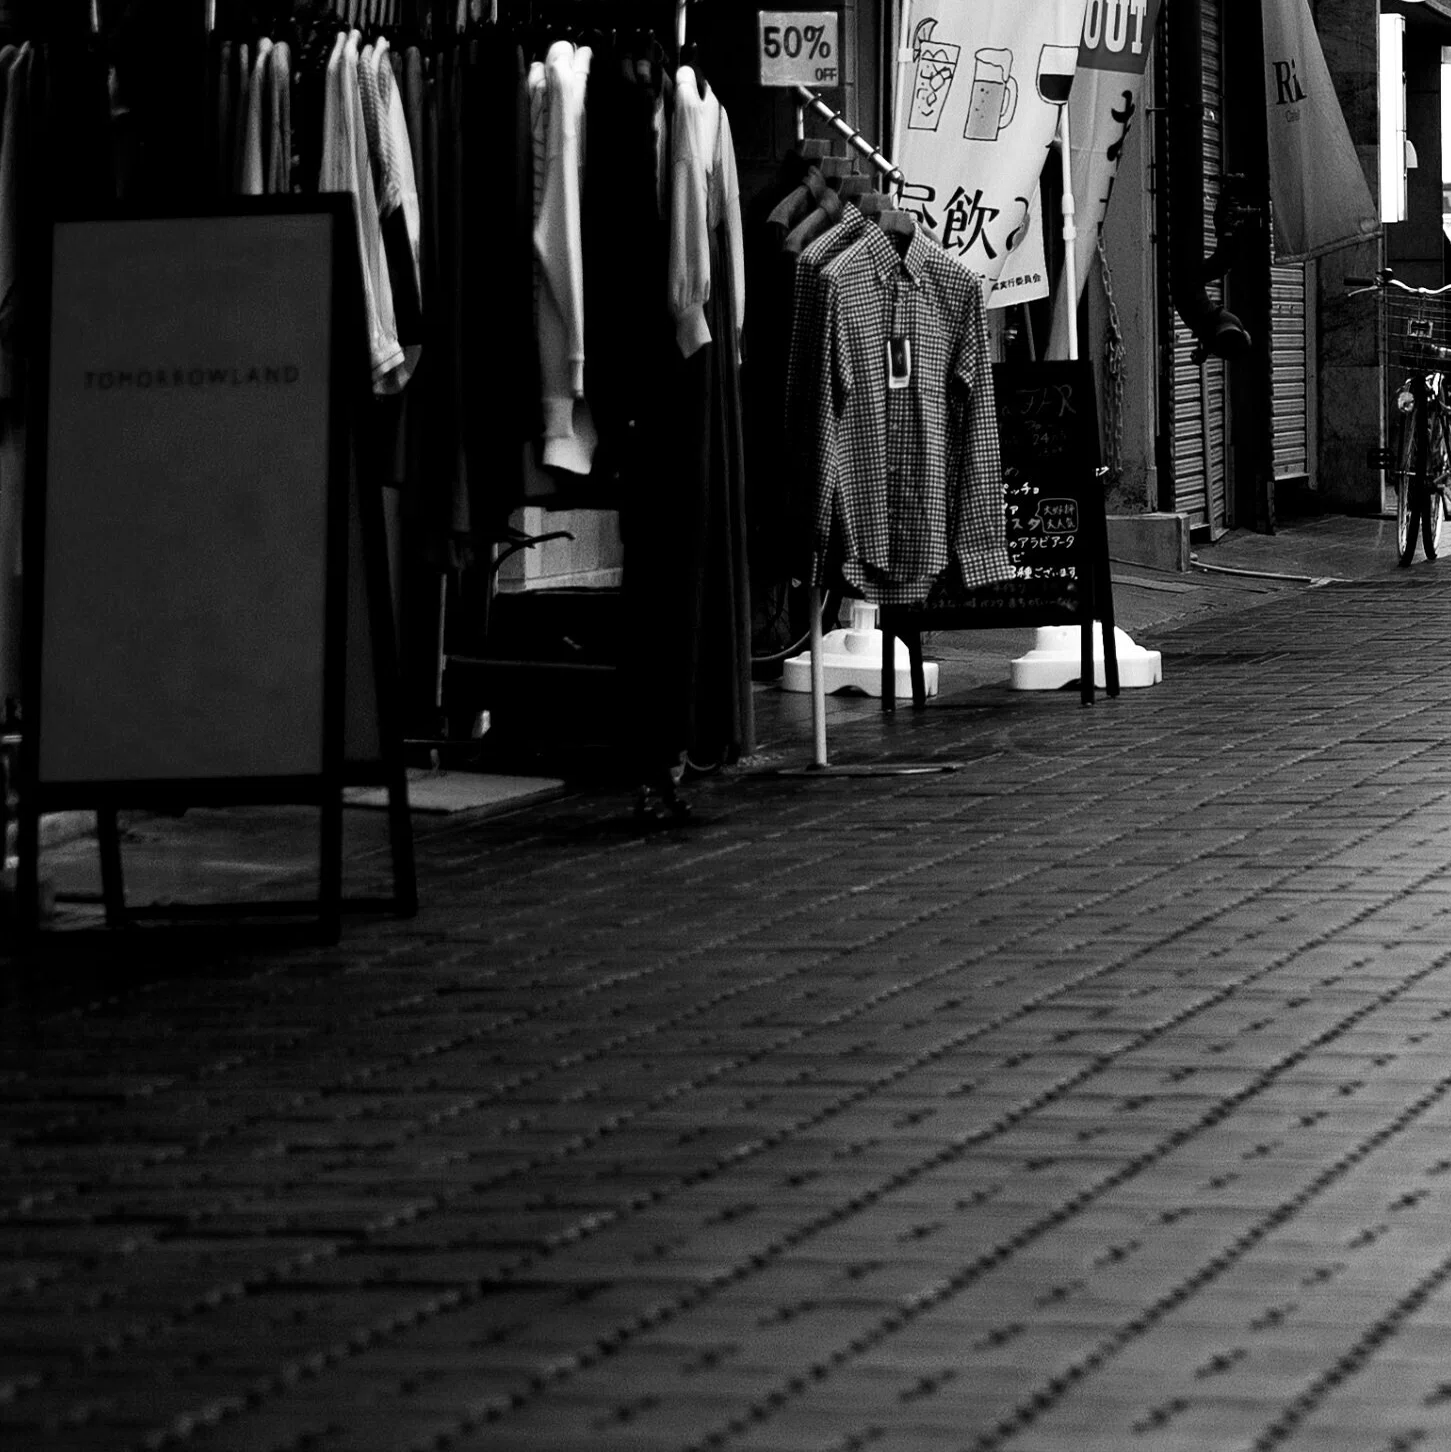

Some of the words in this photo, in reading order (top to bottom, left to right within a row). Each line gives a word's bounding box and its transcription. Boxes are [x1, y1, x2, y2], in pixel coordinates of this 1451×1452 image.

[764, 25, 831, 60] 50%
[815, 68, 837, 81] OFF
[1272, 59, 1307, 105] Ri
[84, 365, 300, 390] TOMORROWLAND
